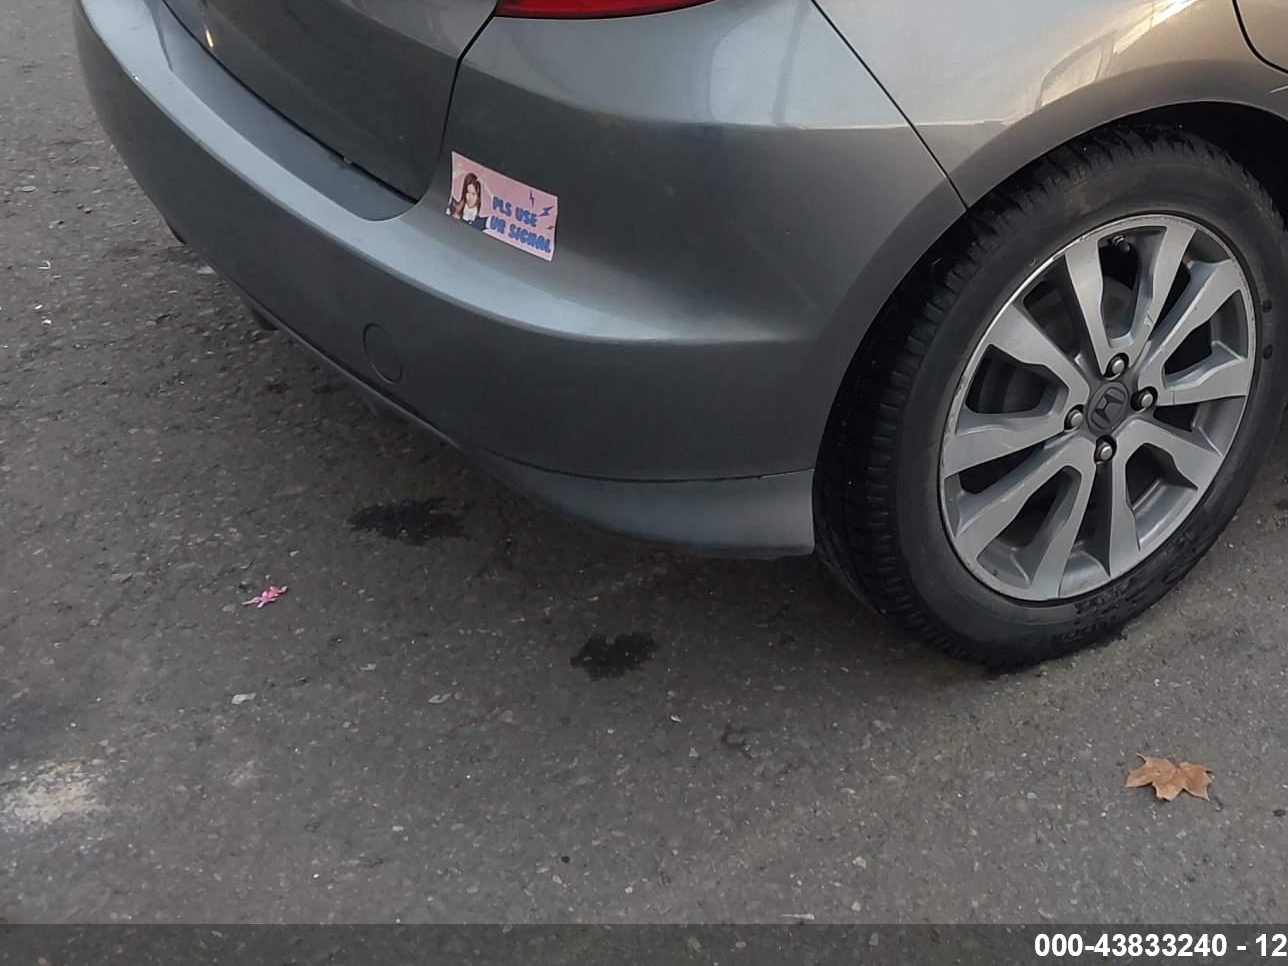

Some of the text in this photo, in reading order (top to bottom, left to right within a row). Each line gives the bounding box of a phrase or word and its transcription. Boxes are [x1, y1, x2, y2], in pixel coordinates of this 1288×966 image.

[492, 196, 538, 228] PLS USE
[490, 215, 551, 253] UR SIGNAL
